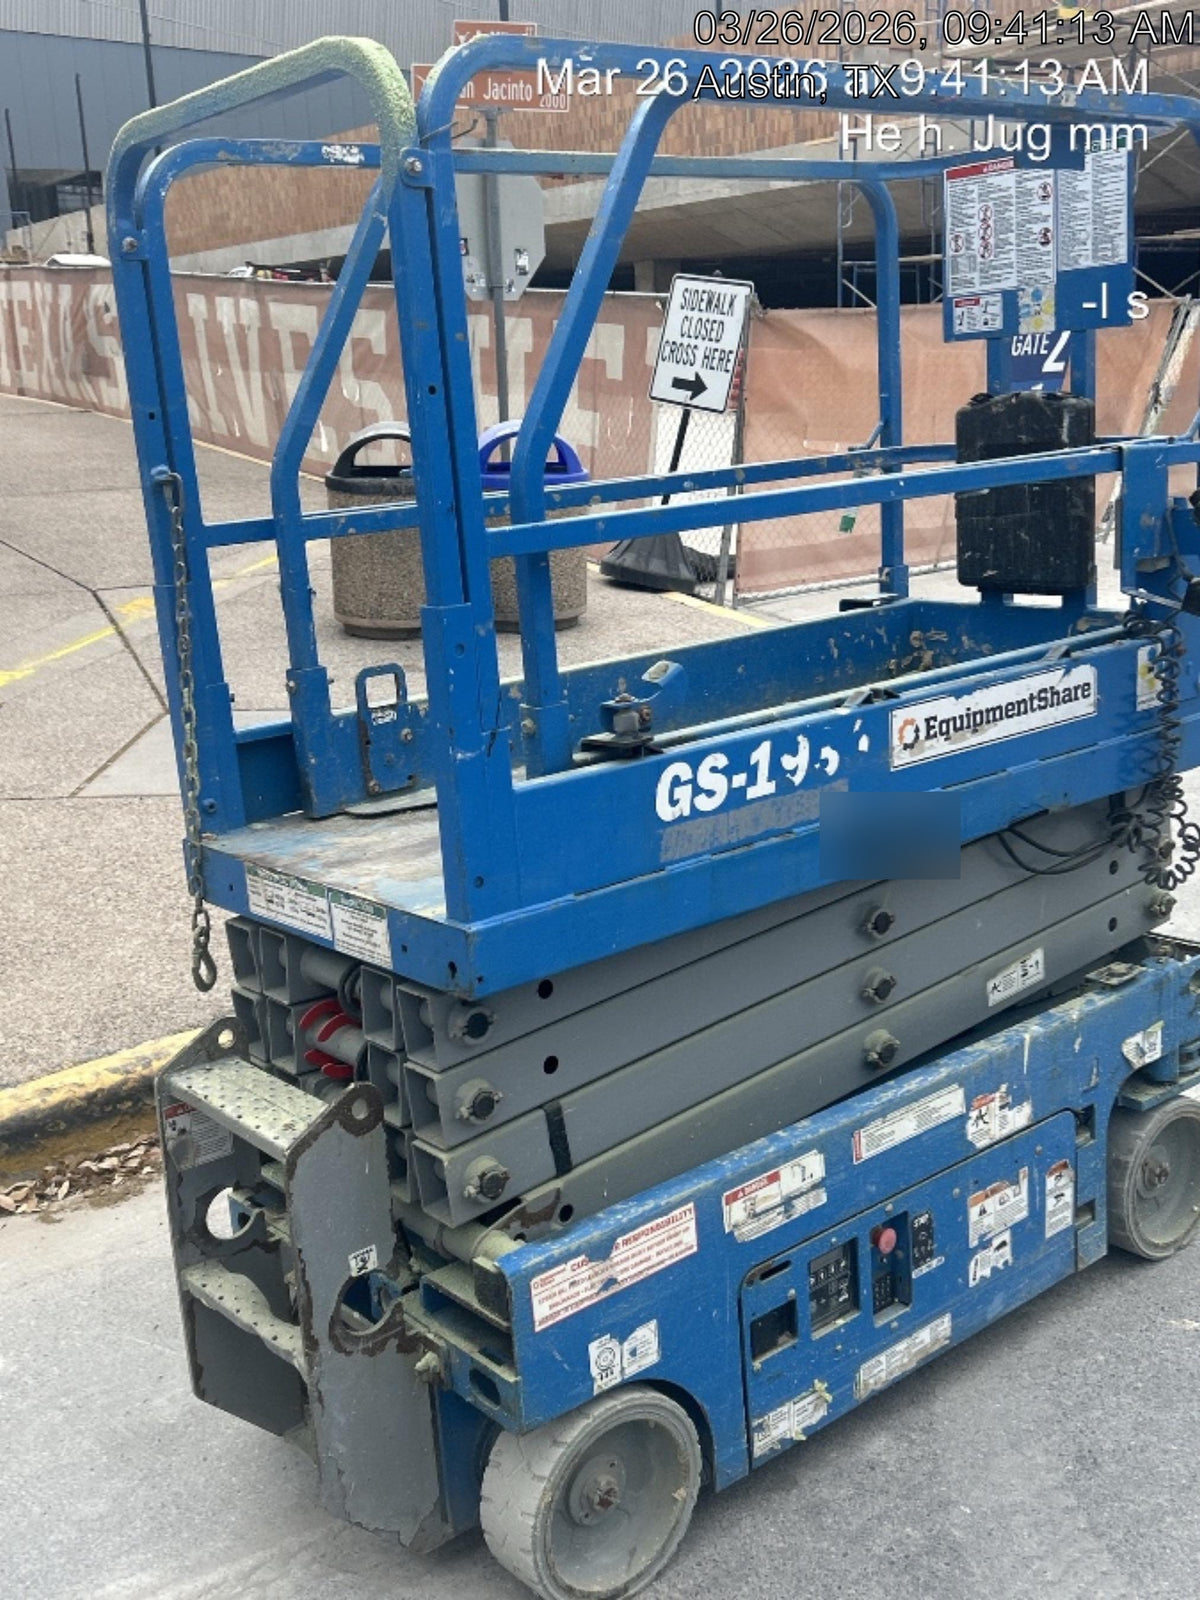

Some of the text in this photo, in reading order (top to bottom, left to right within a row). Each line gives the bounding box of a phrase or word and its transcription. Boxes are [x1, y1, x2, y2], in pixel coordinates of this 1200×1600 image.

[483, 77, 533, 101] Jacinto
[680, 287, 737, 317] SIDEWALK
[680, 315, 725, 343] CLOSED
[1011, 332, 1050, 356] GATE
[660, 339, 735, 373] CROSS HERE
[184, 292, 400, 468] IVES
[924, 682, 1091, 741] EquipmentShare
